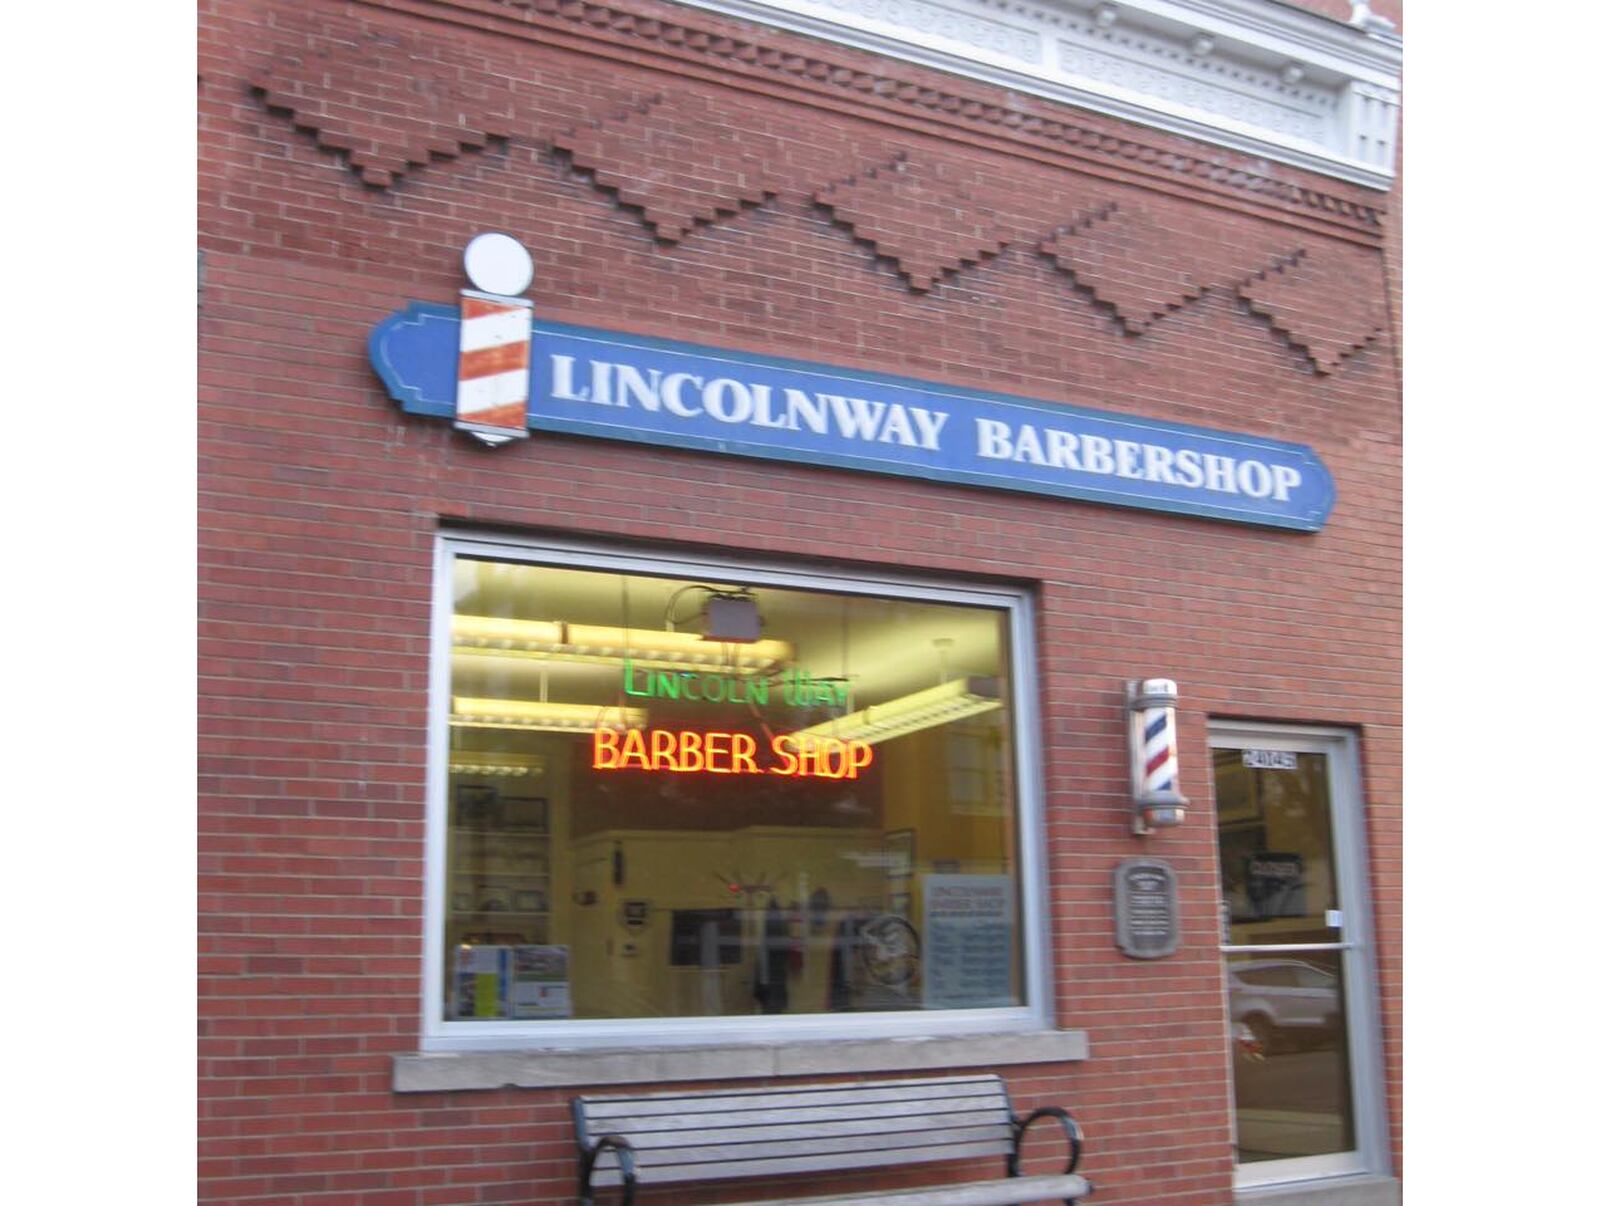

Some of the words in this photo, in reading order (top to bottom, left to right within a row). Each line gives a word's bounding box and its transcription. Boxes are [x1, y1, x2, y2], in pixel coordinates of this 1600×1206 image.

[550, 354, 949, 451] LINCOLNWAY
[976, 416, 1303, 503] BARBERSHOP
[592, 727, 759, 774] BARBER
[770, 734, 873, 779] SHOP
